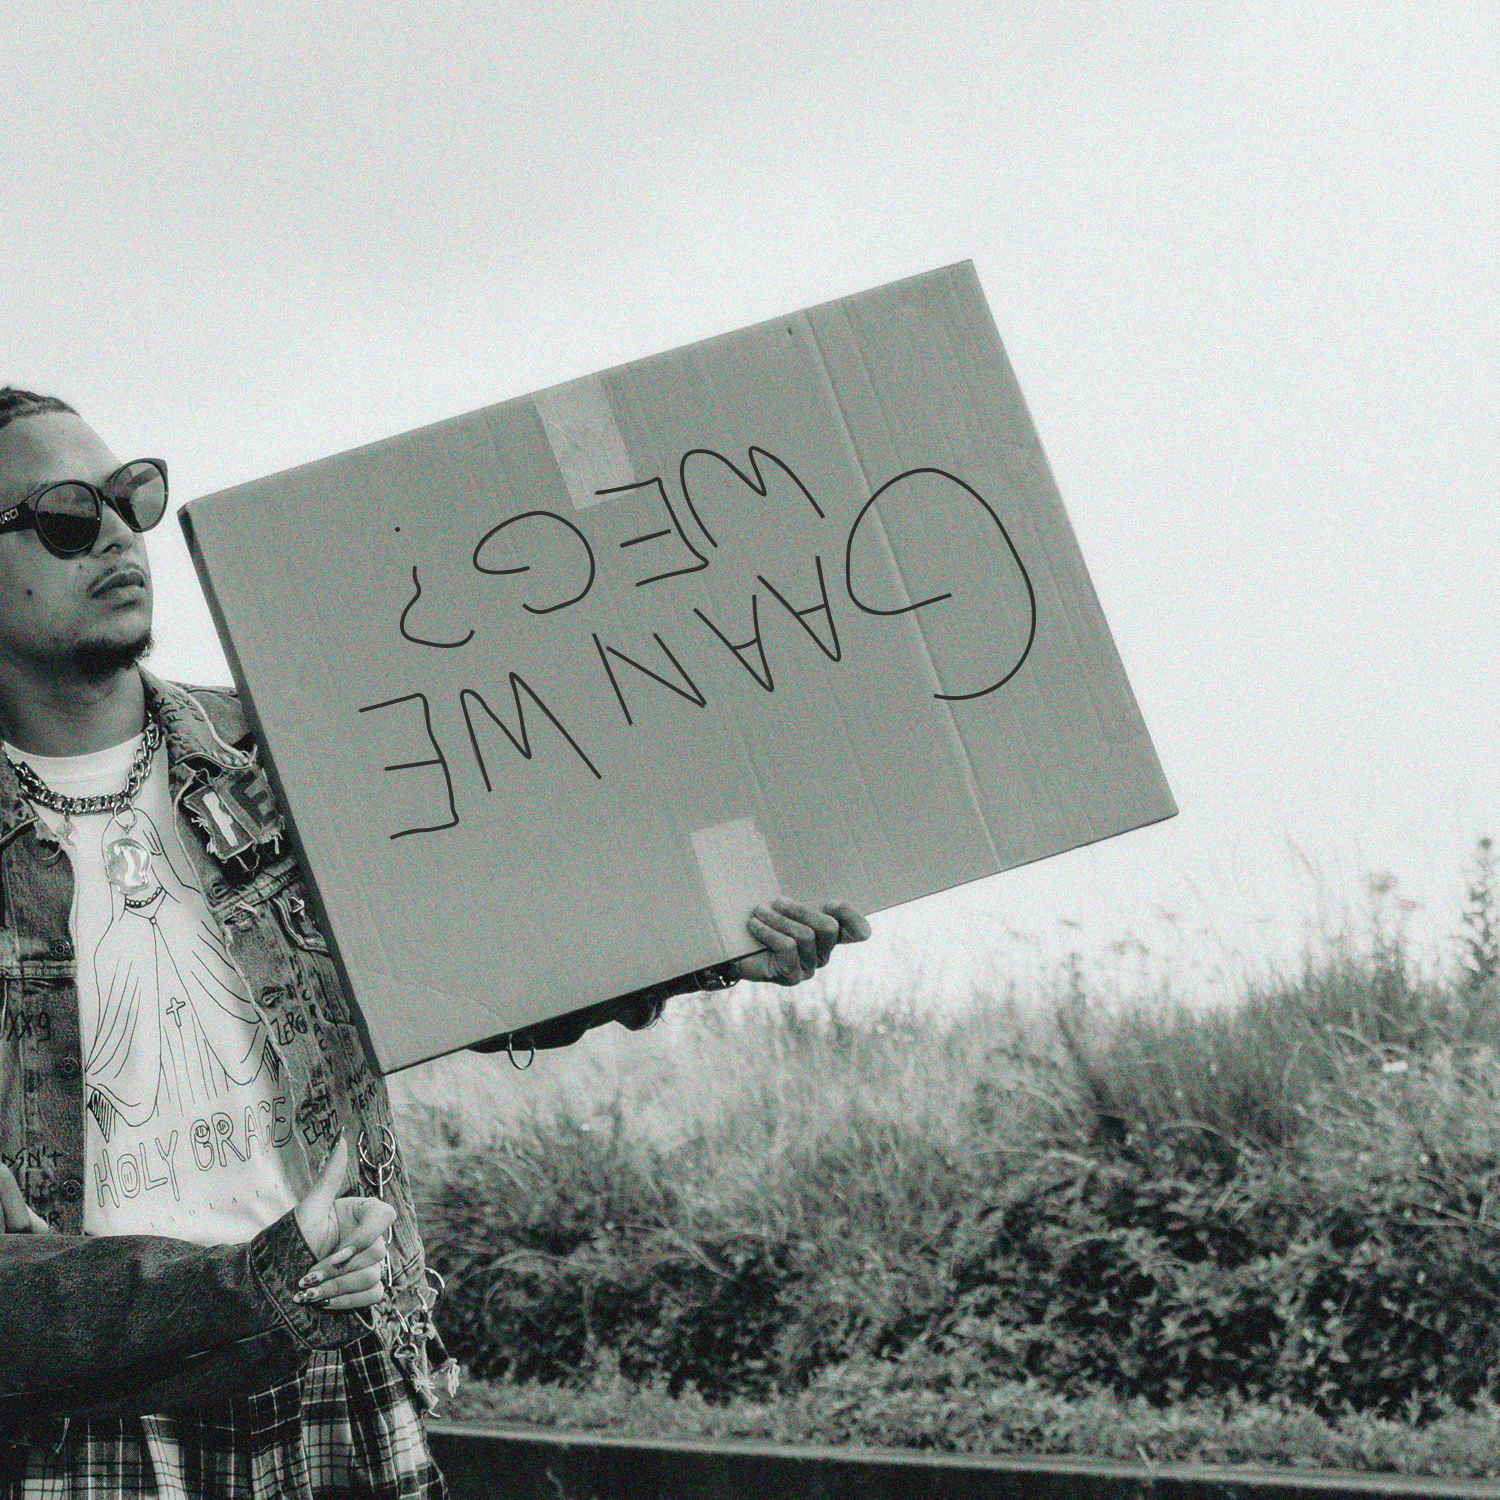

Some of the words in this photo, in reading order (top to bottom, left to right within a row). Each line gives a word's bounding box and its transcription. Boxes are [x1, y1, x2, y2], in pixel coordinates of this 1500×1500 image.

[590, 467, 1038, 728] GAAN
[357, 671, 602, 840] WE
[93, 1129, 180, 1208] HOLY
